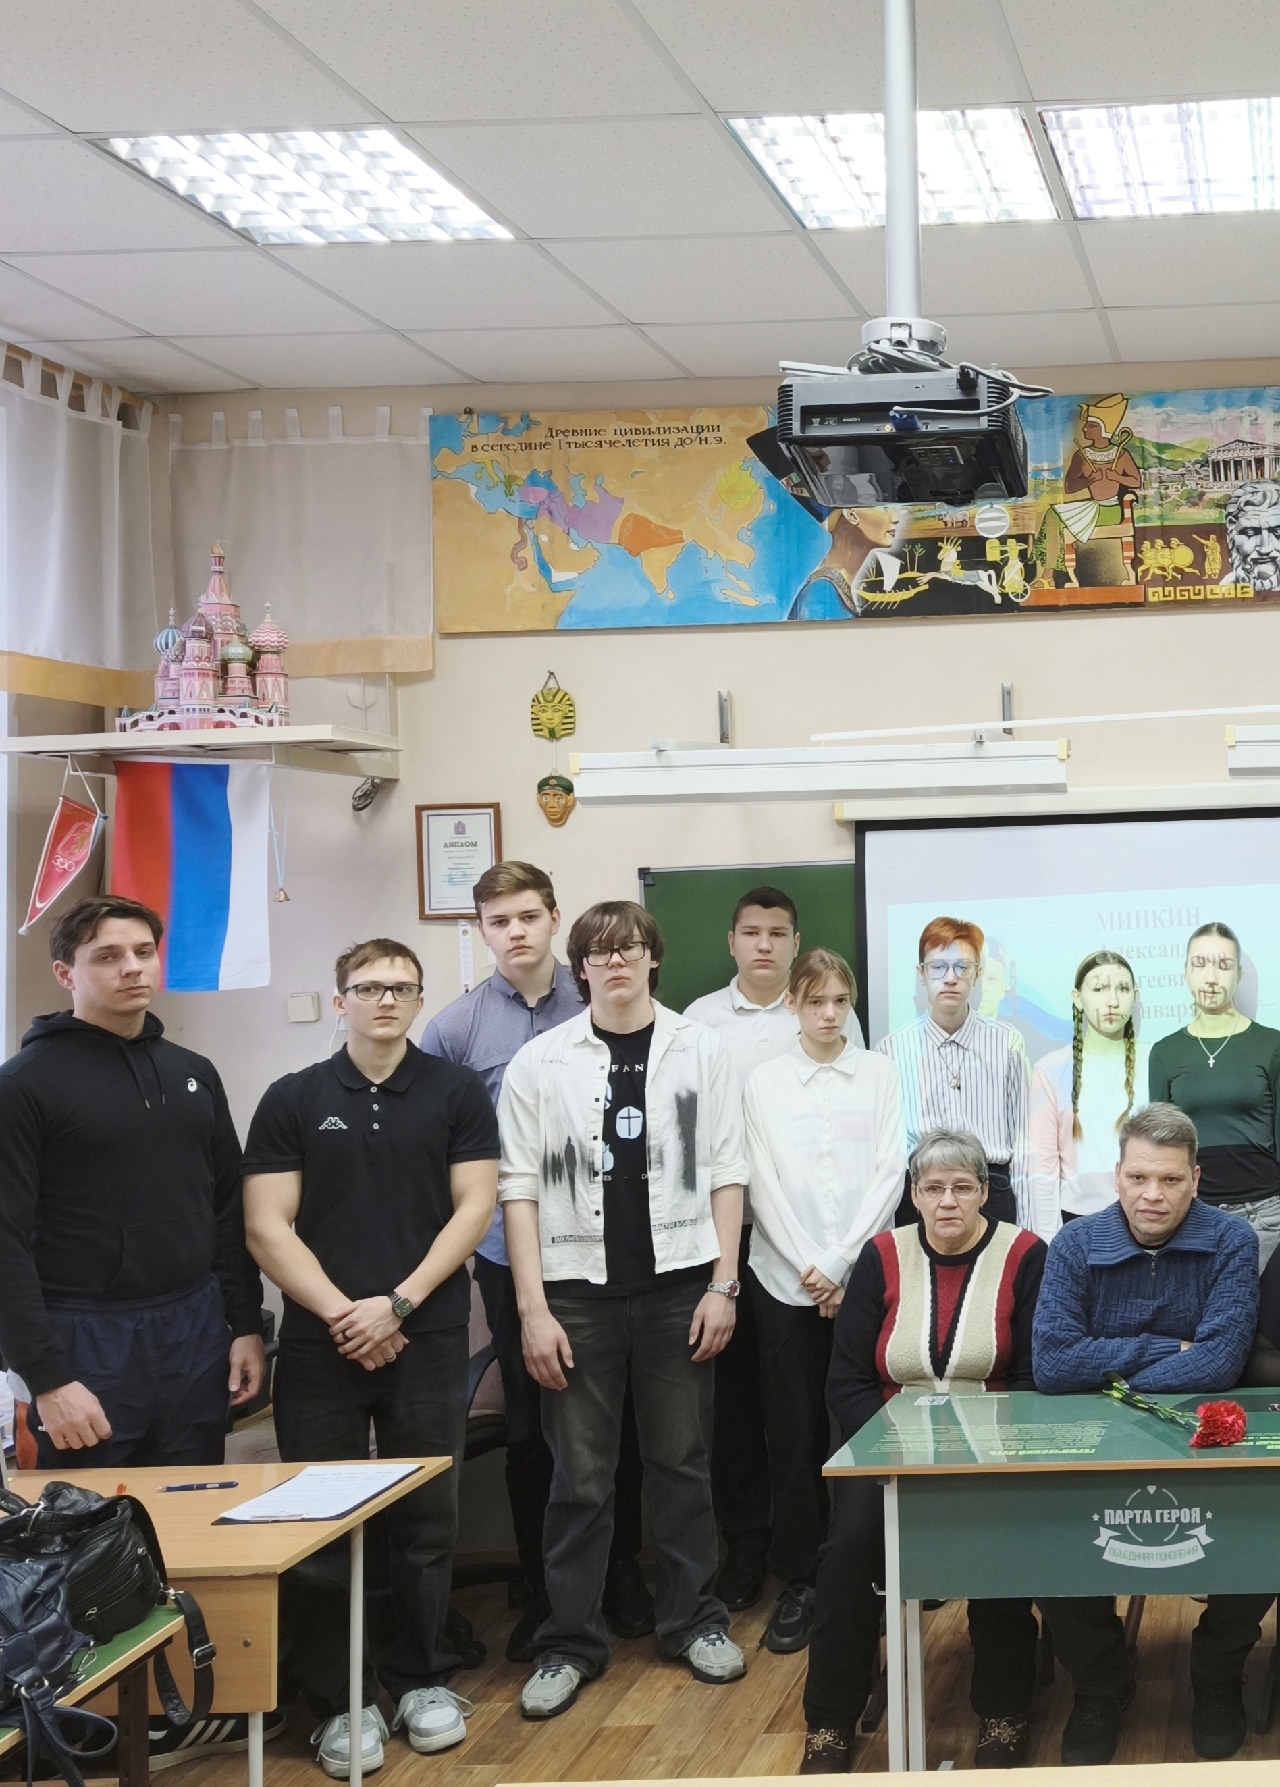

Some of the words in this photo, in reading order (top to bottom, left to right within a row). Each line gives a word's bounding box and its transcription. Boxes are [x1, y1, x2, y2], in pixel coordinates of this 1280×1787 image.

[52, 854, 75, 871] 350
[1096, 907, 1201, 932] МИНКИН
[1104, 1509, 1153, 1525] ПАРТА
[1155, 1507, 1201, 1524] ГЕРОЯ
